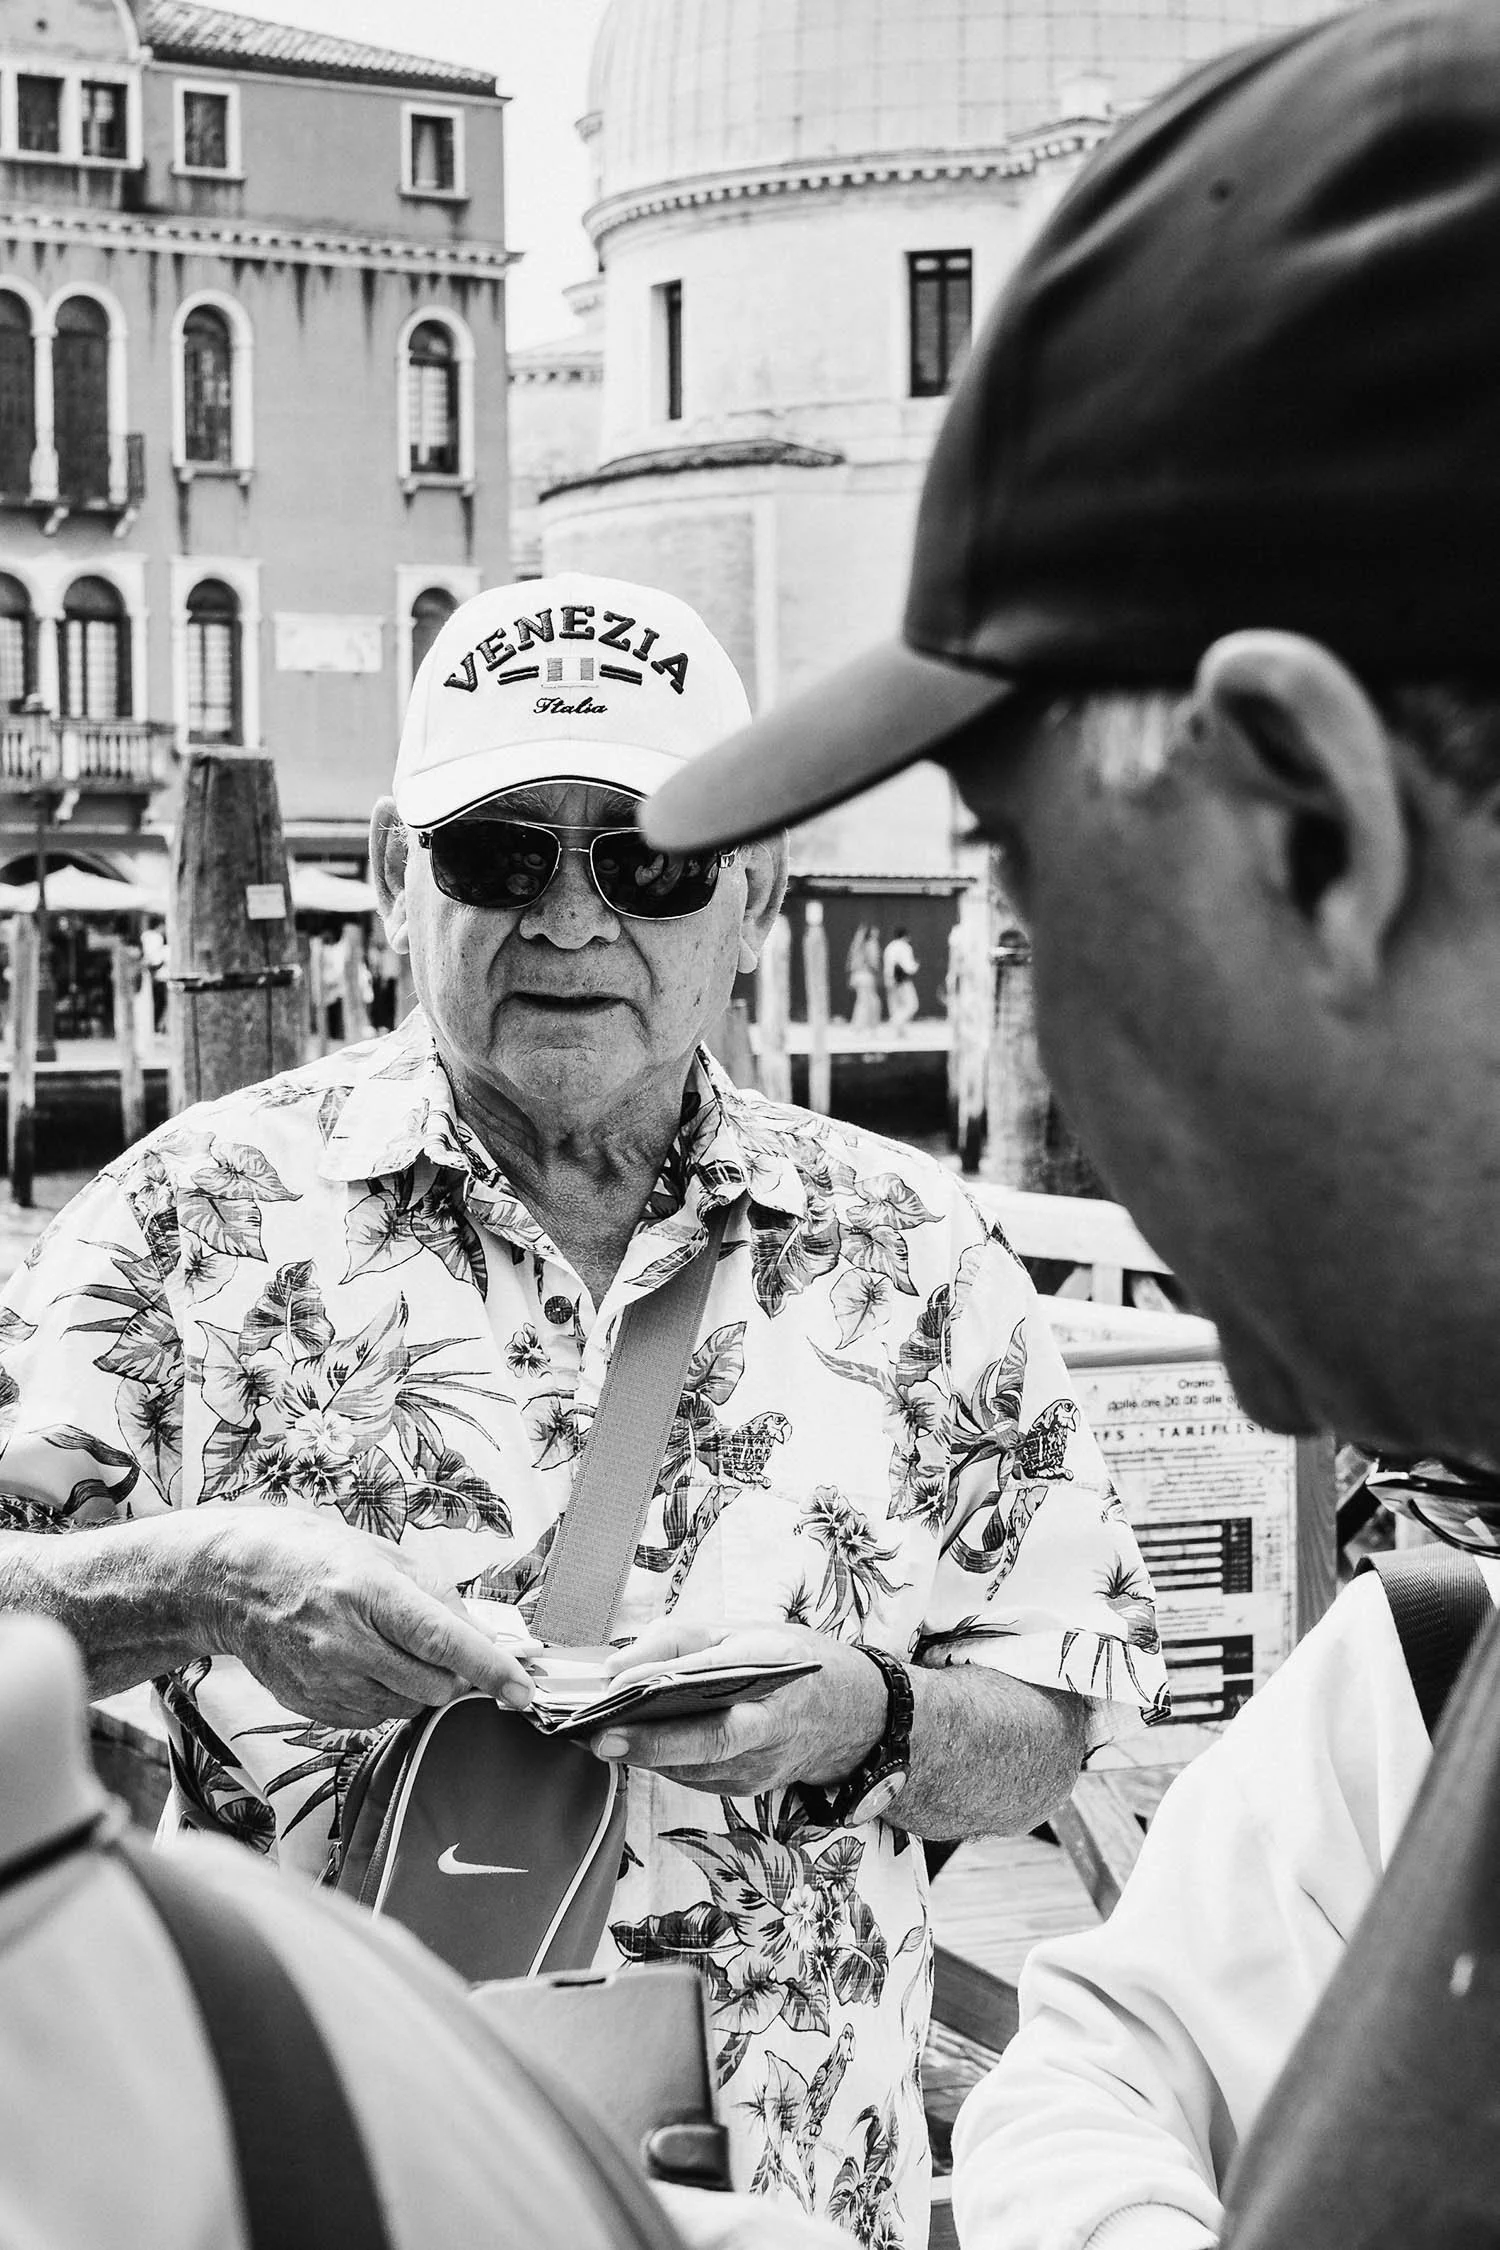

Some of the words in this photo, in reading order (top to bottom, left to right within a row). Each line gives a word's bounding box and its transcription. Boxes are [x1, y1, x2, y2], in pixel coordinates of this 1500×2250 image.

[443, 605, 689, 695] VENEZIA
[533, 696, 608, 714] Italia
[1092, 1430, 1125, 1442] IFS
